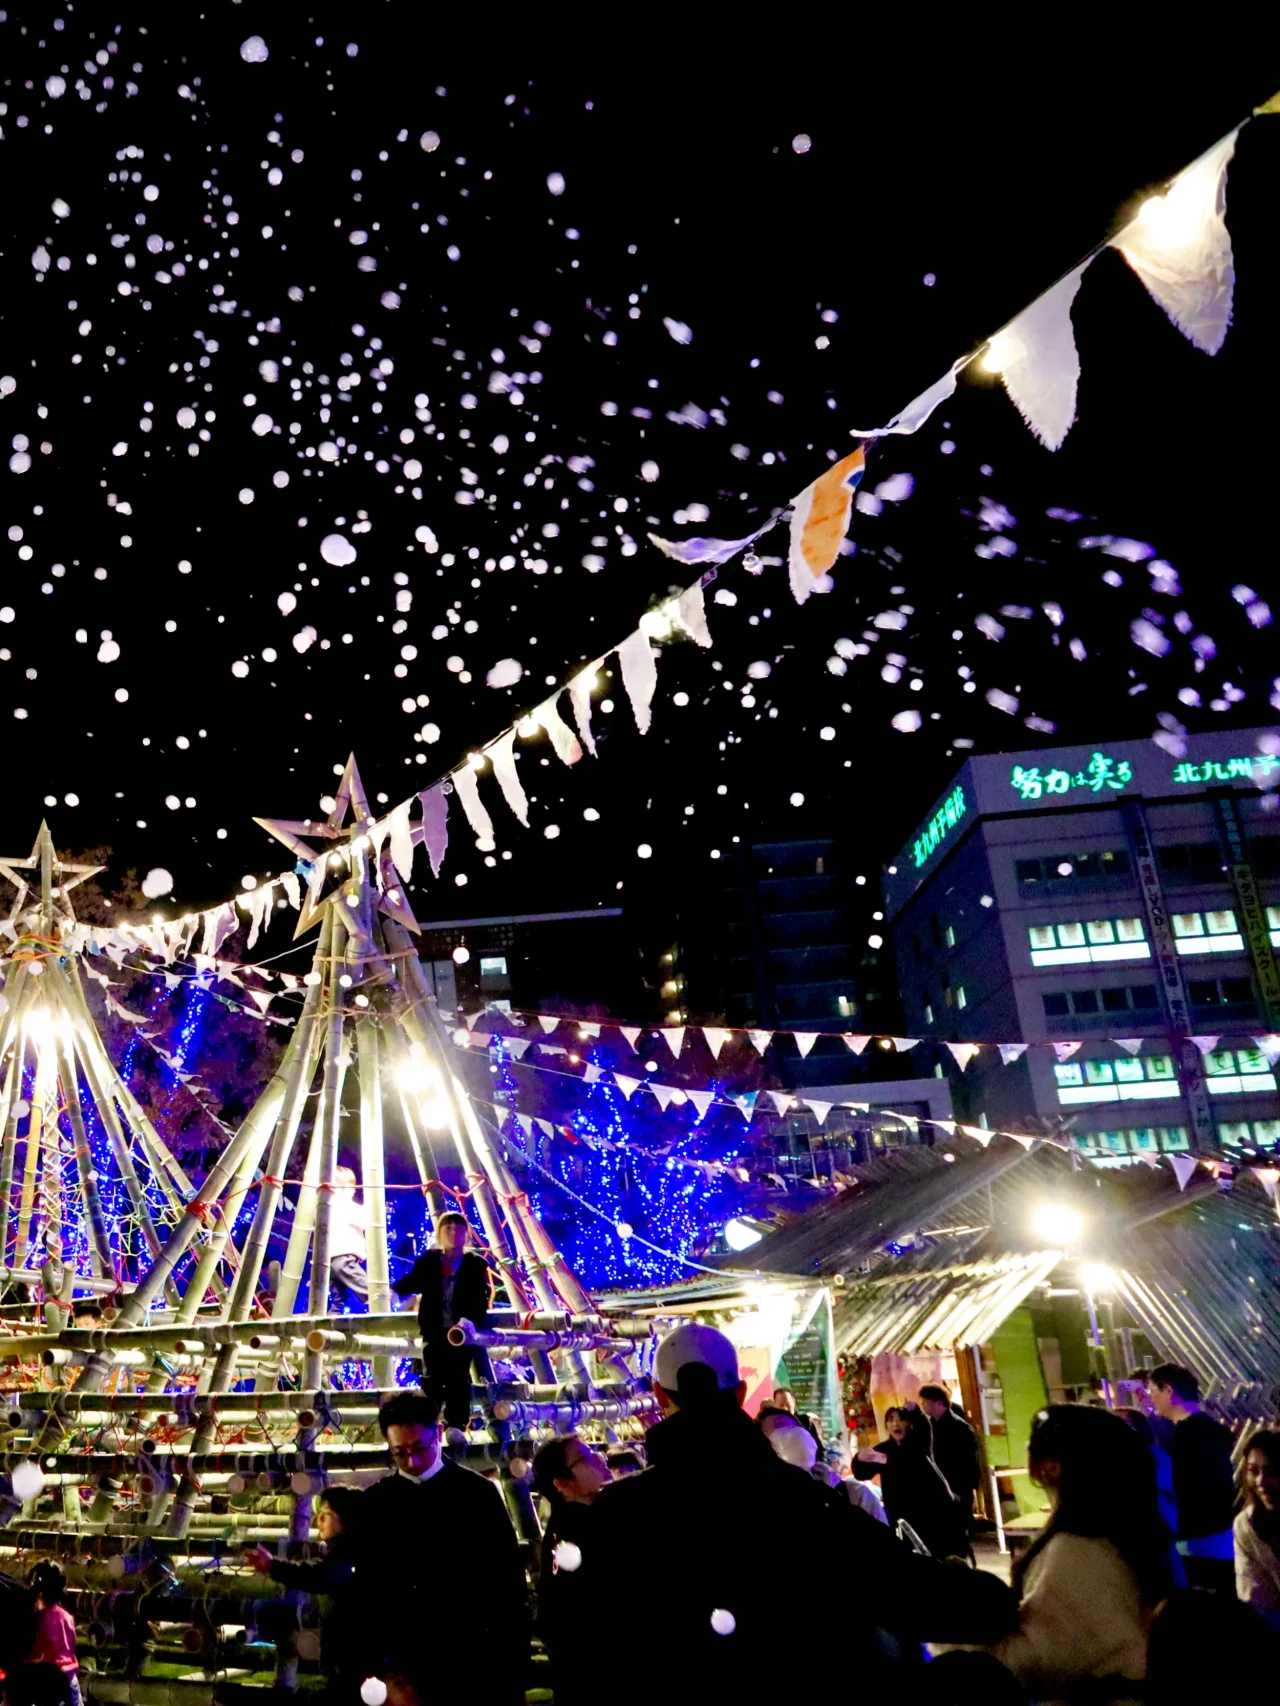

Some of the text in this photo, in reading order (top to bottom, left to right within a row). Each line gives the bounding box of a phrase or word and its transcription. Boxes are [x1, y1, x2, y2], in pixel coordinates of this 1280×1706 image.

[1011, 752, 1133, 798] 努力は実る
[914, 785, 966, 867] 北九州予備校
